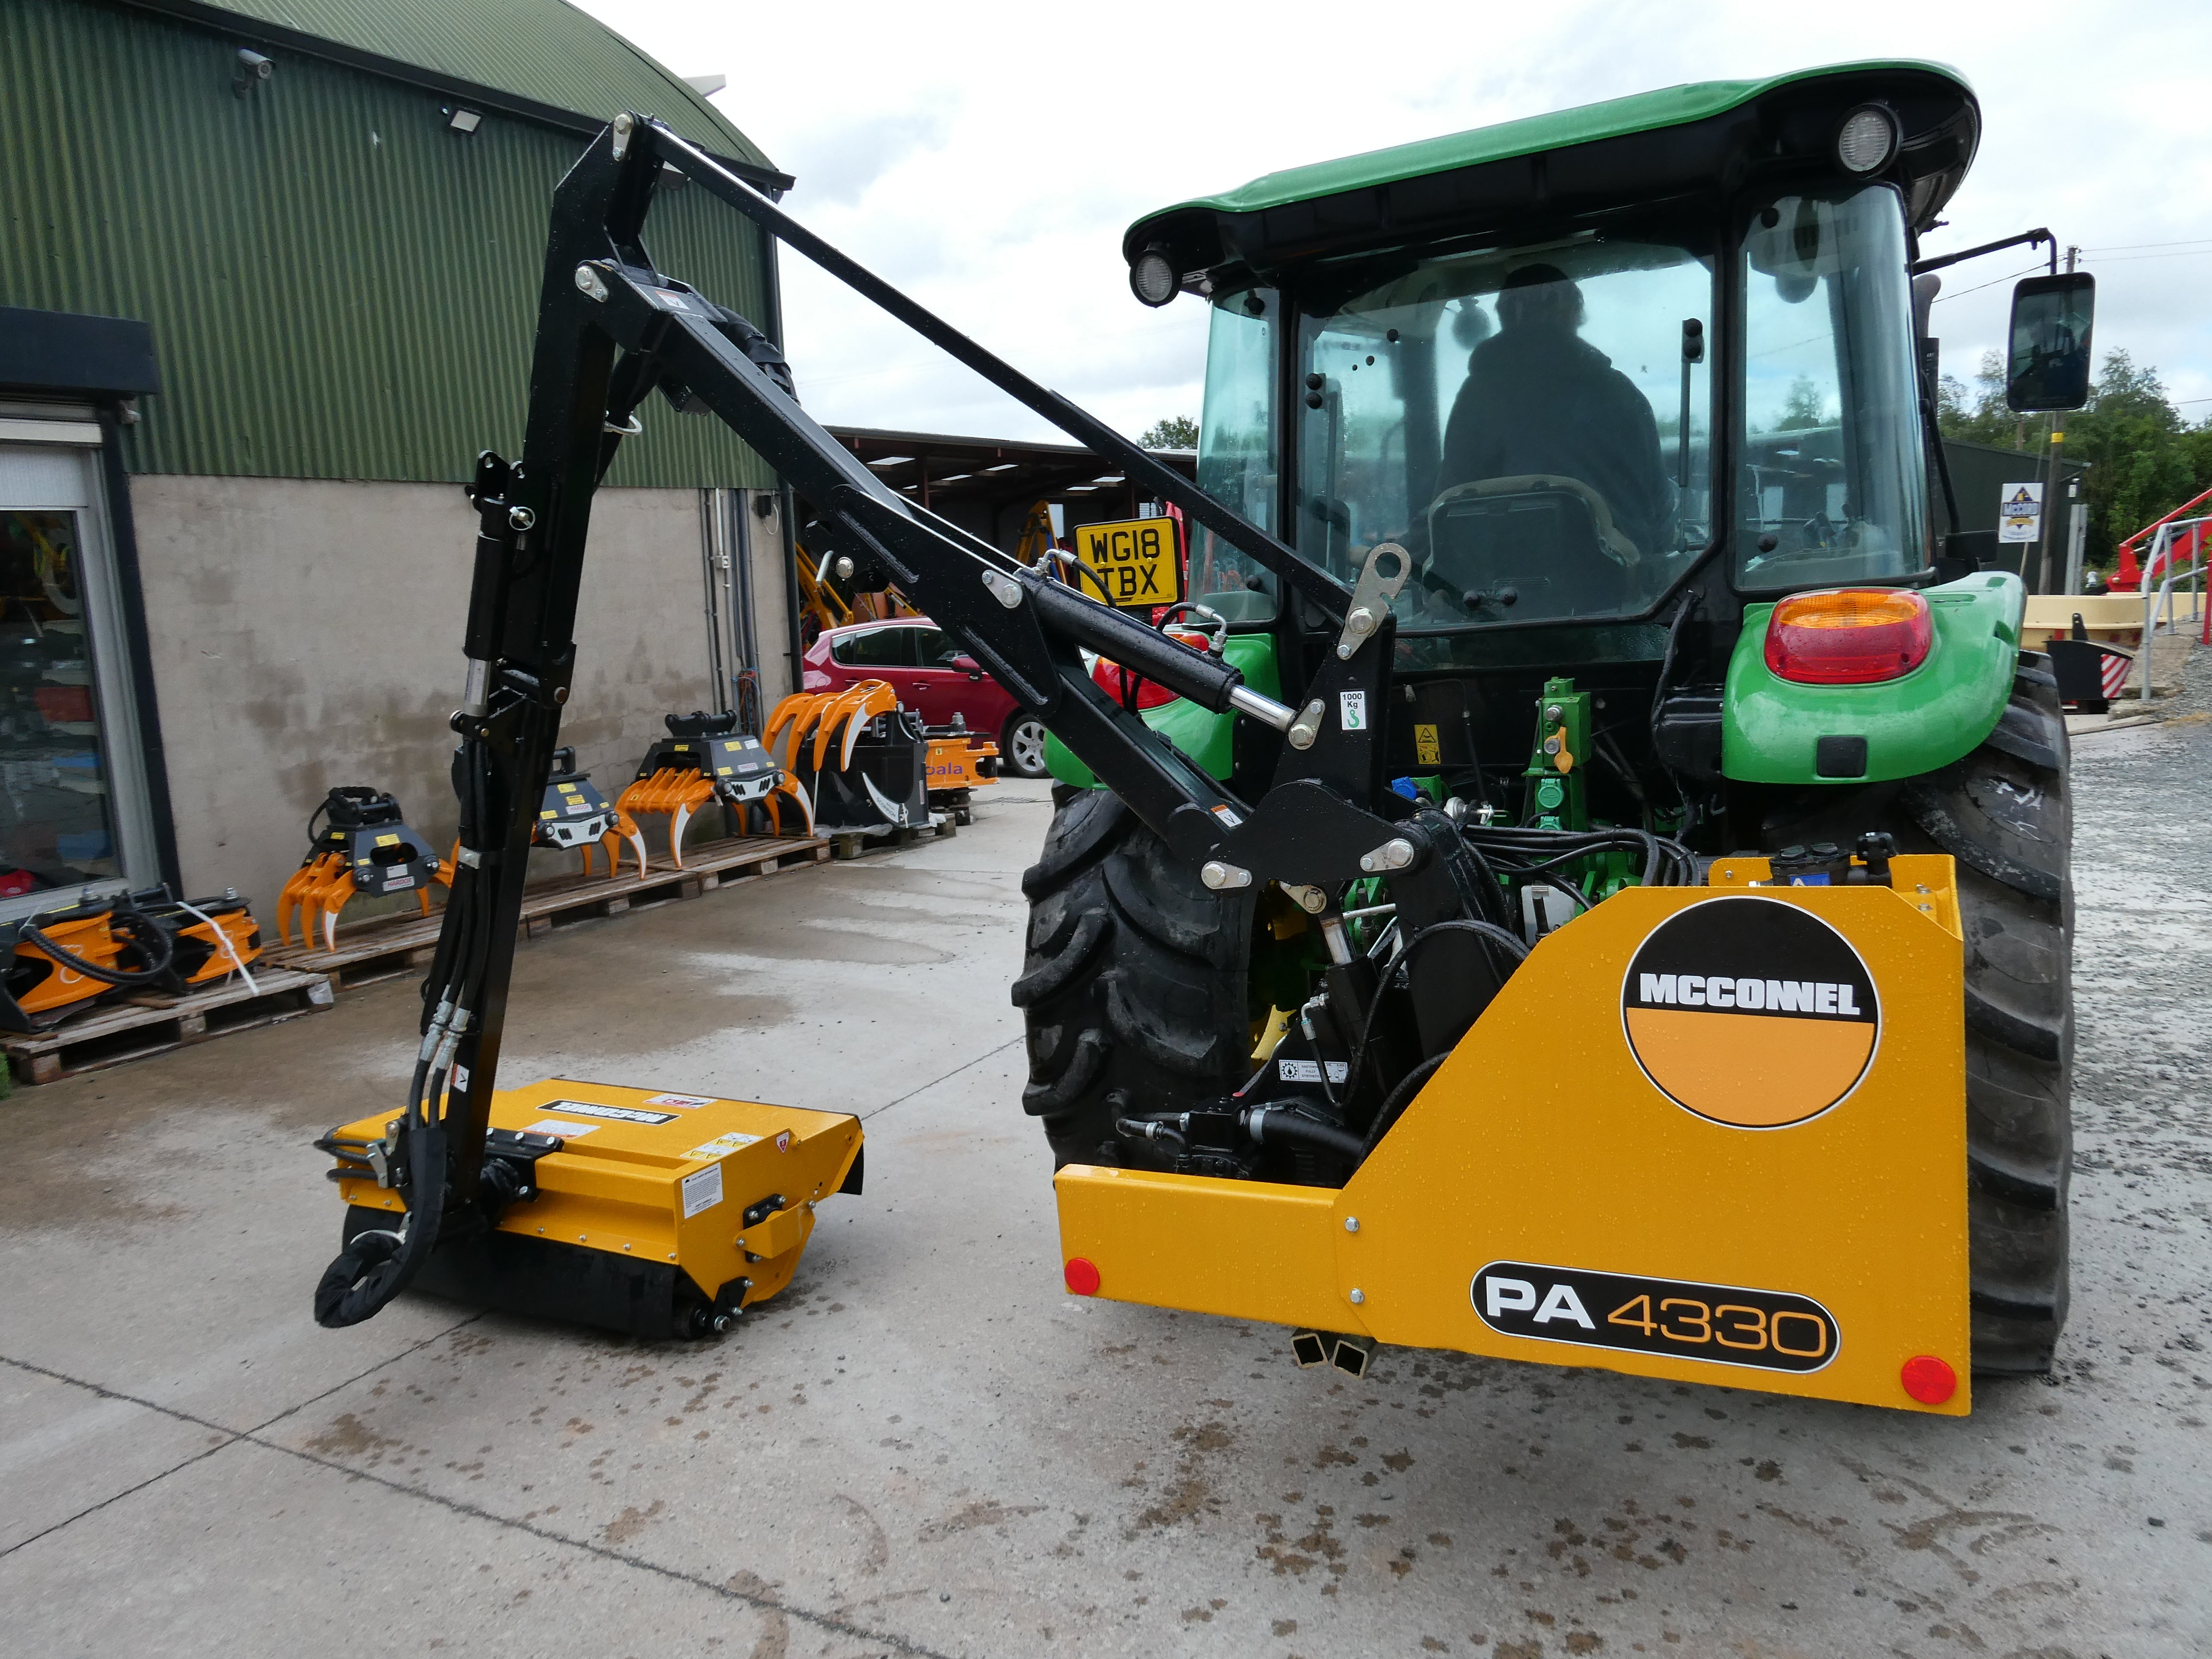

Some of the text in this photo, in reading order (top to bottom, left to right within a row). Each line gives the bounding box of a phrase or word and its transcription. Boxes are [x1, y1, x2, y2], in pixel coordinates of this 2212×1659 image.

[1090, 528, 1160, 563] WG18
[1097, 564, 1159, 597] TBX
[1347, 701, 1358, 709] Kg
[925, 762, 963, 775] oala
[387, 877, 412, 887] HARDOX
[1640, 973, 1861, 1015] MCCONNEL
[1485, 1275, 1827, 1357] PA 4330
